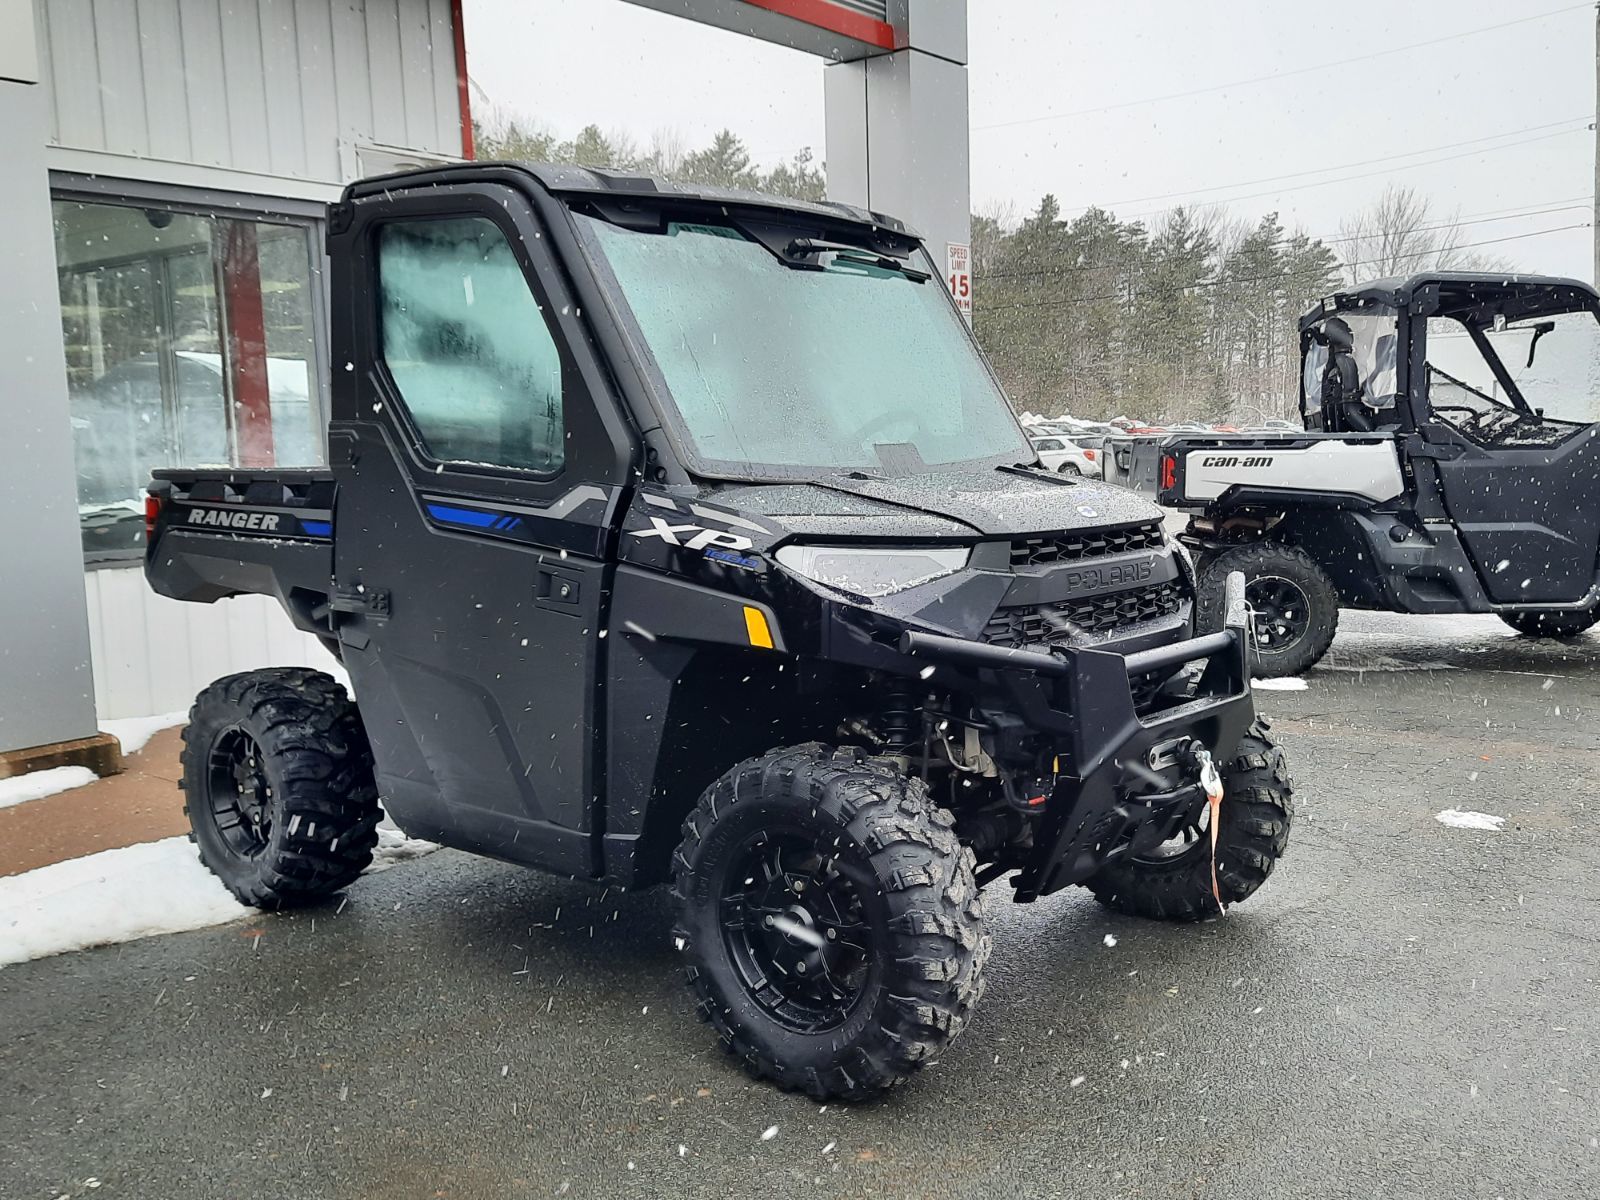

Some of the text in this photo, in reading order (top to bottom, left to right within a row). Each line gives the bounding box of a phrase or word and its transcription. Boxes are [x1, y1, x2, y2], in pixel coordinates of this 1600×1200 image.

[949, 247, 968, 259] SPEED
[951, 259, 966, 271] LIMIT
[949, 274, 969, 297] 15
[1202, 456, 1274, 468] can-am
[187, 508, 280, 531] RANGER
[628, 517, 753, 550] XP
[703, 549, 759, 568] 1000
[1066, 561, 1152, 594] POLARIS
